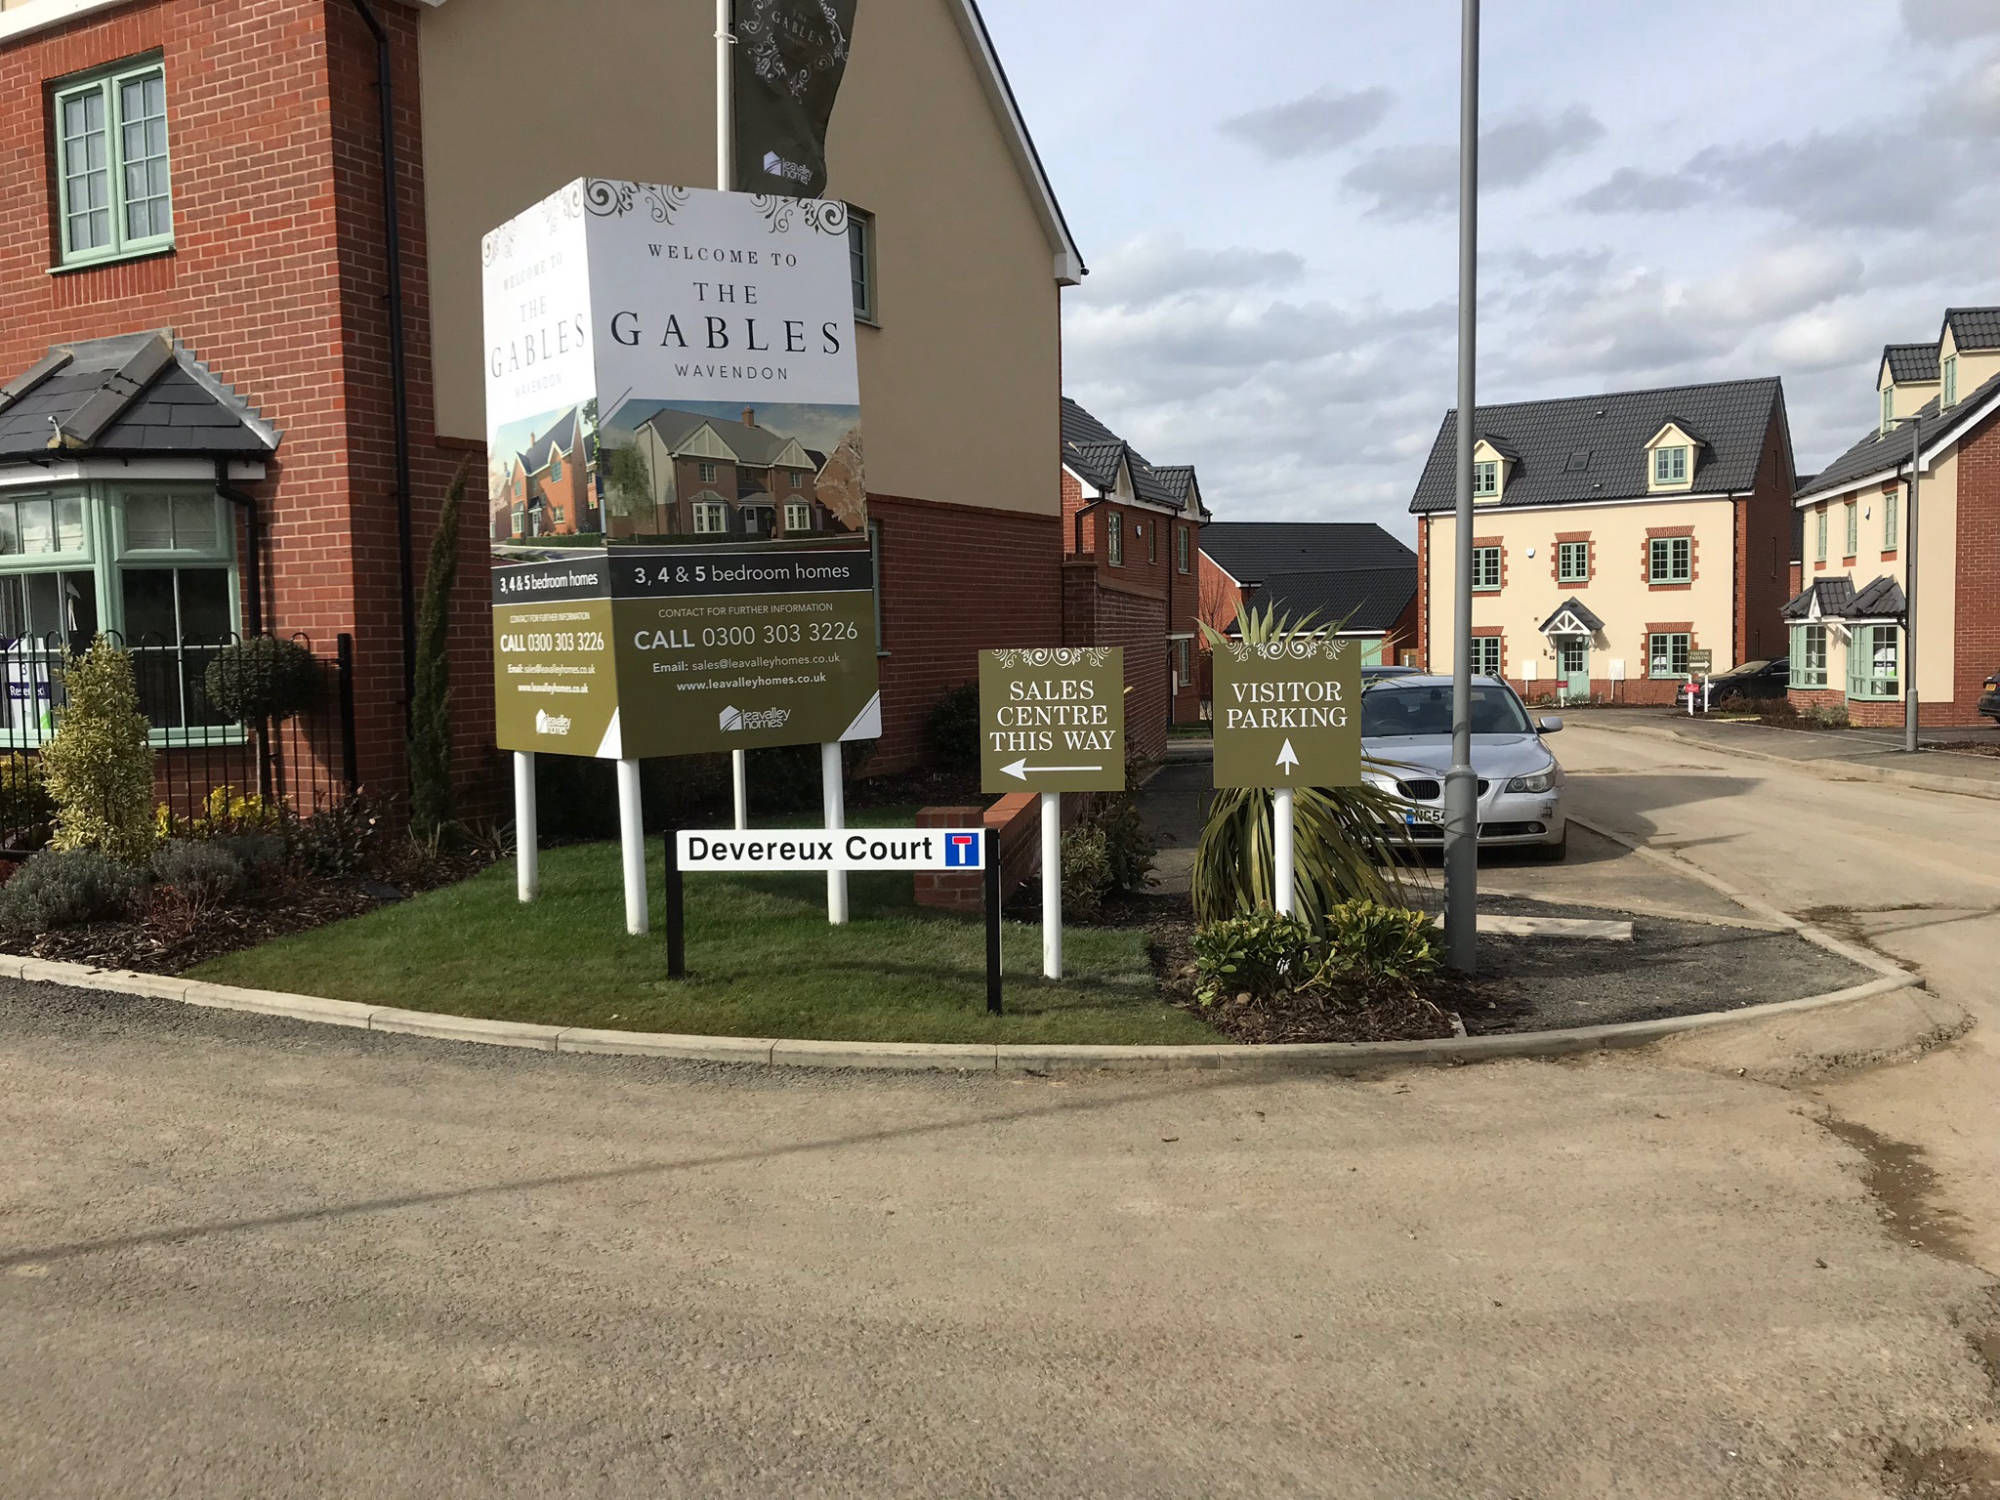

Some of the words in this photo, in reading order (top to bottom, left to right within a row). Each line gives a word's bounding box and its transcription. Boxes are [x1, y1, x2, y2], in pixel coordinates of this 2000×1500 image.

[648, 243, 758, 264] WELCOME
[771, 253, 797, 267] TO
[693, 282, 757, 304] THE
[520, 296, 546, 322] THE
[610, 311, 840, 355] GABLES
[491, 313, 584, 378] GABLES
[675, 363, 788, 380] WAVENDON
[500, 577, 509, 594] 3,
[509, 576, 516, 591] 4
[516, 576, 524, 590] &
[524, 575, 530, 590] 5
[532, 572, 568, 590] bedroom
[569, 570, 599, 587] homes
[634, 567, 652, 586] 3,
[657, 566, 670, 583] 4
[676, 566, 689, 583] &
[695, 565, 706, 582] 5
[711, 564, 789, 582] bedroom
[795, 562, 850, 580] homes
[658, 607, 704, 618] CONTACT
[707, 606, 726, 616] FOR
[728, 604, 768, 615] FURTHER
[771, 602, 833, 614] INFORMATION
[500, 634, 526, 652] CALL
[527, 633, 552, 651] 0300
[556, 632, 575, 651] 303
[577, 632, 604, 651] 3226
[634, 629, 695, 650] CALL
[702, 626, 755, 646] 0300
[763, 624, 800, 643] 303
[808, 621, 858, 641] 3226
[653, 661, 689, 673] Email:
[692, 652, 840, 670] sales@leavalleyhomes.co.uk
[677, 672, 826, 691] www.leavalleyhomes.co.uk
[1009, 679, 1095, 701] SALES
[1231, 681, 1342, 703] VISITOR
[742, 707, 791, 721] leavalley
[743, 719, 784, 730] homes
[996, 705, 1108, 726] CENTRE
[1226, 707, 1348, 729] PARKING
[989, 731, 1053, 752] THIS
[1064, 730, 1116, 751] WAY
[688, 836, 833, 861] Devereux
[845, 835, 933, 861] Court
